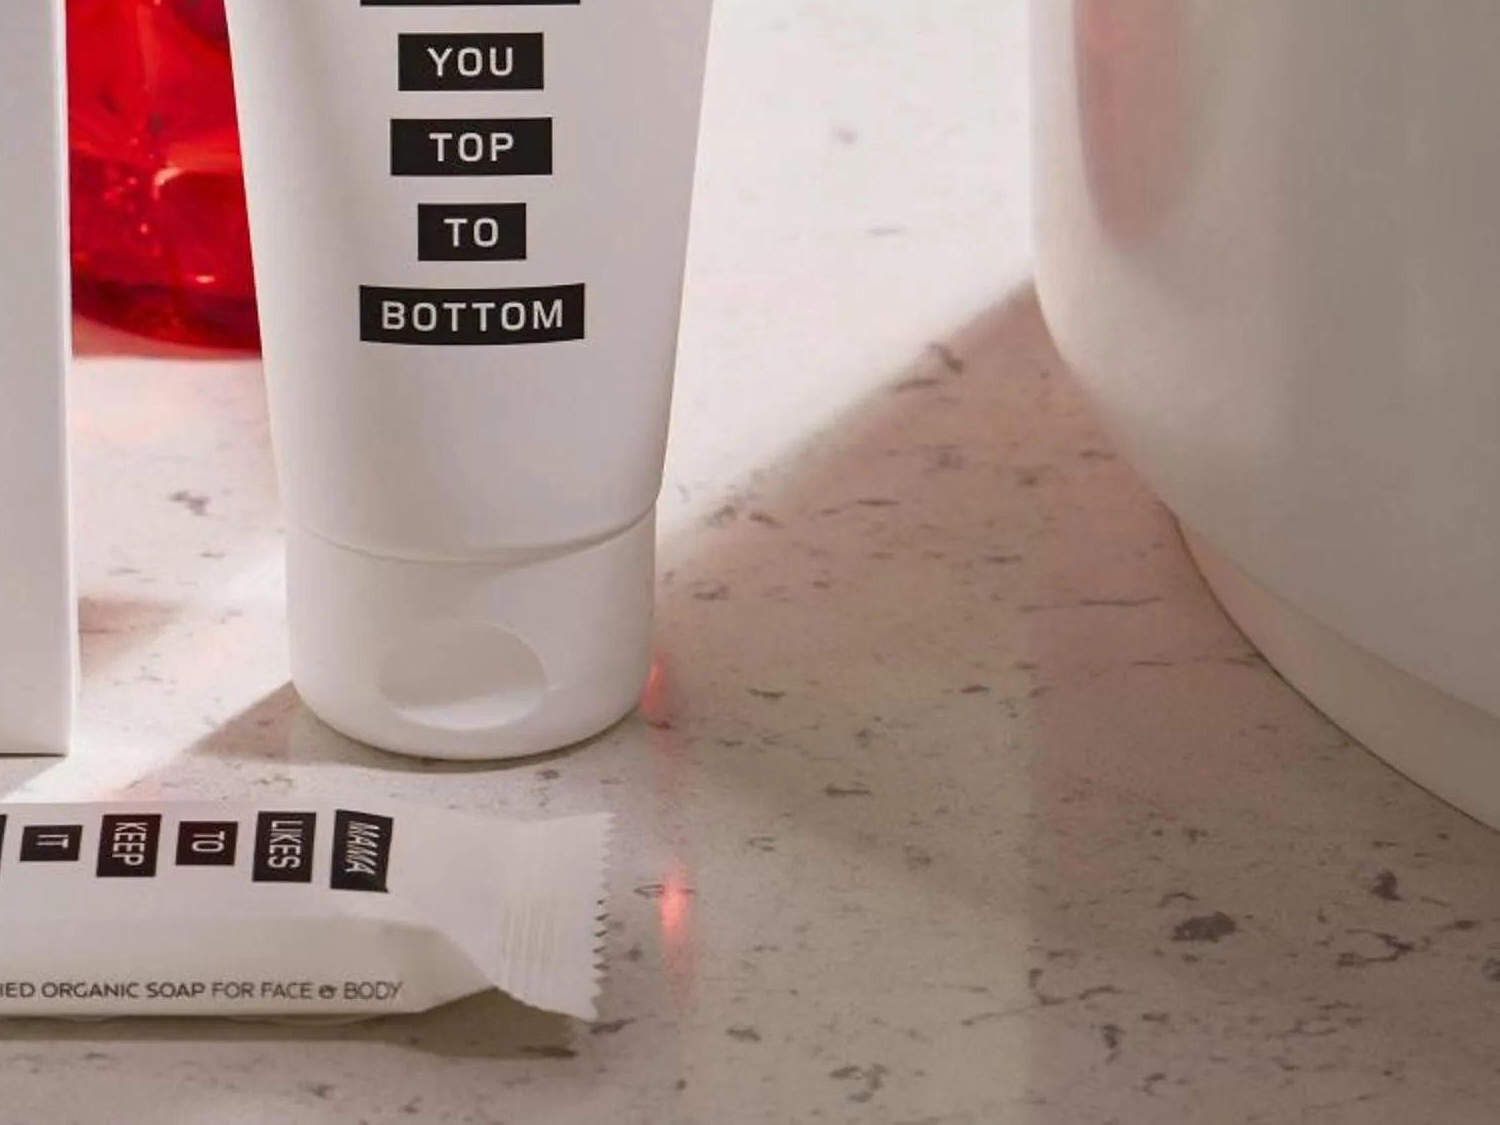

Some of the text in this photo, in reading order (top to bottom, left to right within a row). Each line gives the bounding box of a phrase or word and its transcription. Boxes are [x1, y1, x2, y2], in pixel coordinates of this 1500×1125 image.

[427, 47, 513, 77] YOU
[429, 132, 514, 162] TOP
[443, 217, 499, 247] TO
[382, 299, 563, 332] BOTTOM
[36, 833, 70, 849] IT
[112, 821, 149, 867] KEEP
[192, 829, 227, 853] TO
[267, 819, 303, 869] LIKES
[344, 820, 382, 876] MAMA
[41, 981, 140, 998] ORGANIC
[147, 981, 206, 998] SOAP
[211, 981, 255, 999] FOR
[260, 982, 313, 999] FACE
[343, 981, 403, 1000] BODY
